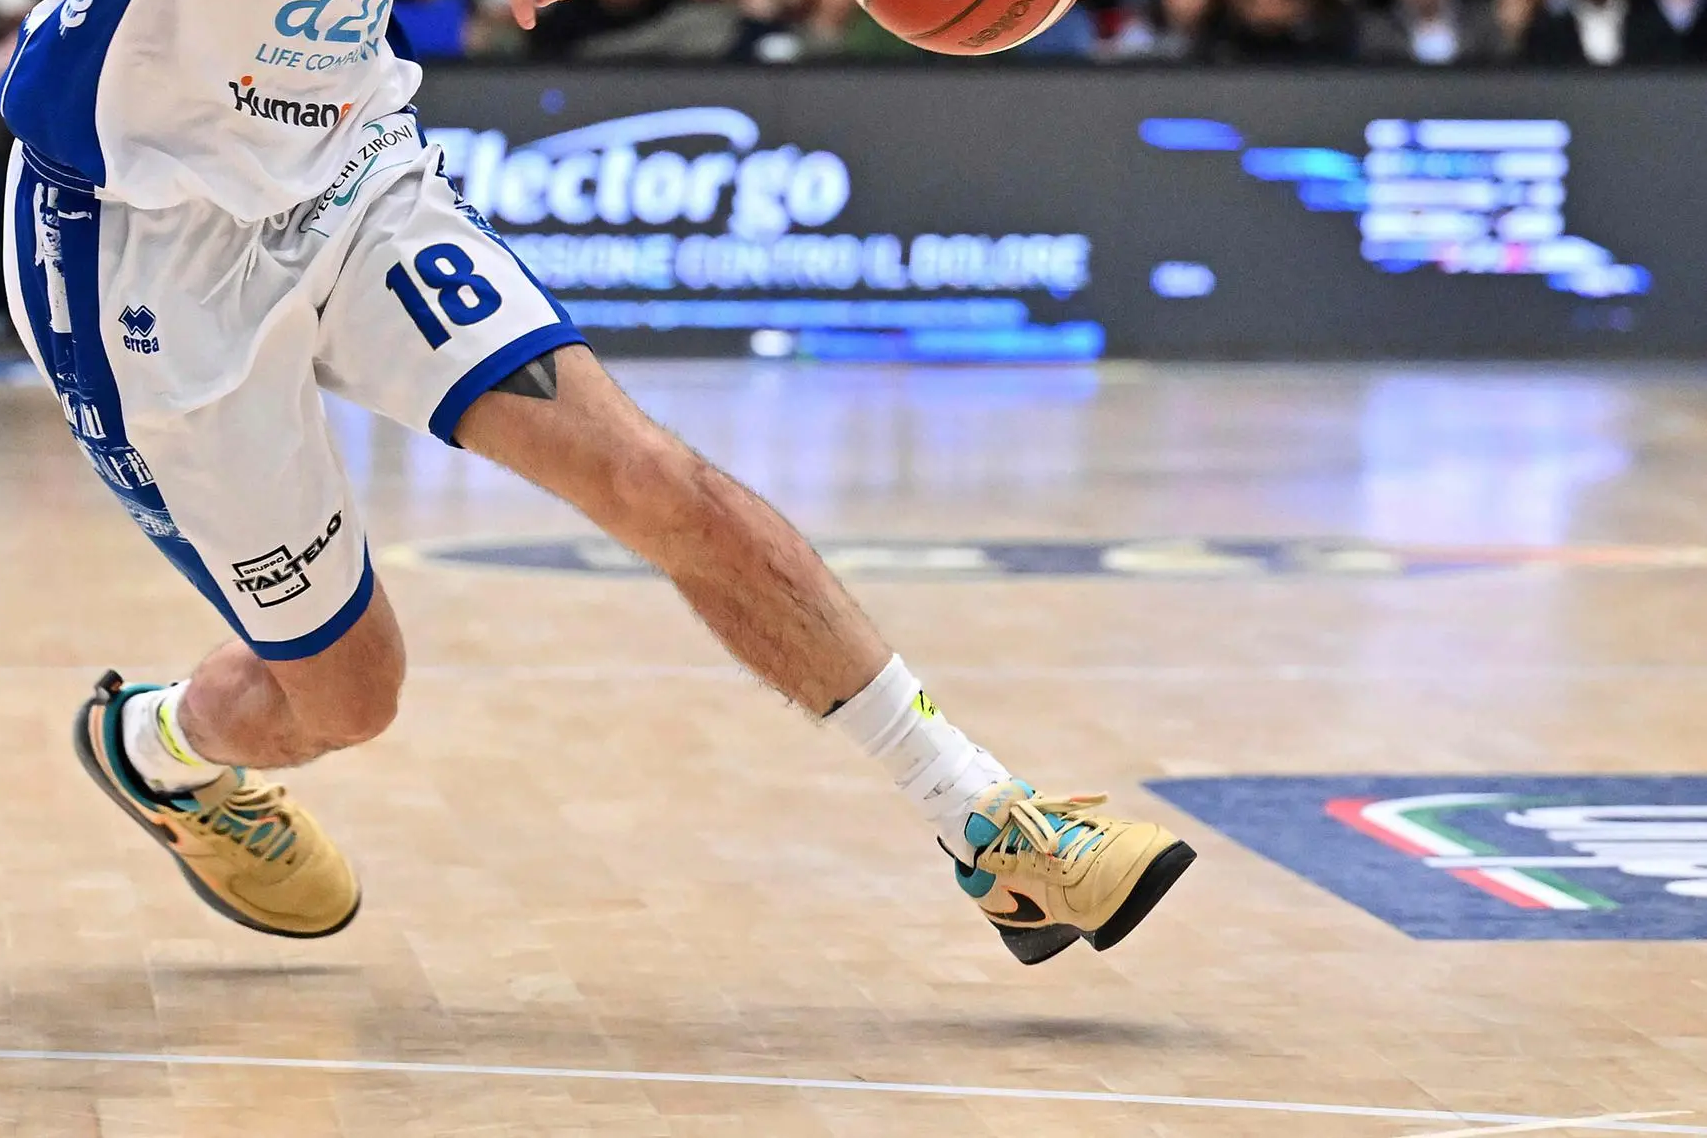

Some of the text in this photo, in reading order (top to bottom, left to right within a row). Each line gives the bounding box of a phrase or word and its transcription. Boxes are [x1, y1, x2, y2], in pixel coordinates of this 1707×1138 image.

[255, 43, 304, 68] LIFE
[312, 125, 413, 222] VECCHI ZIRONI
[385, 243, 502, 351] 18
[123, 334, 160, 354] errea
